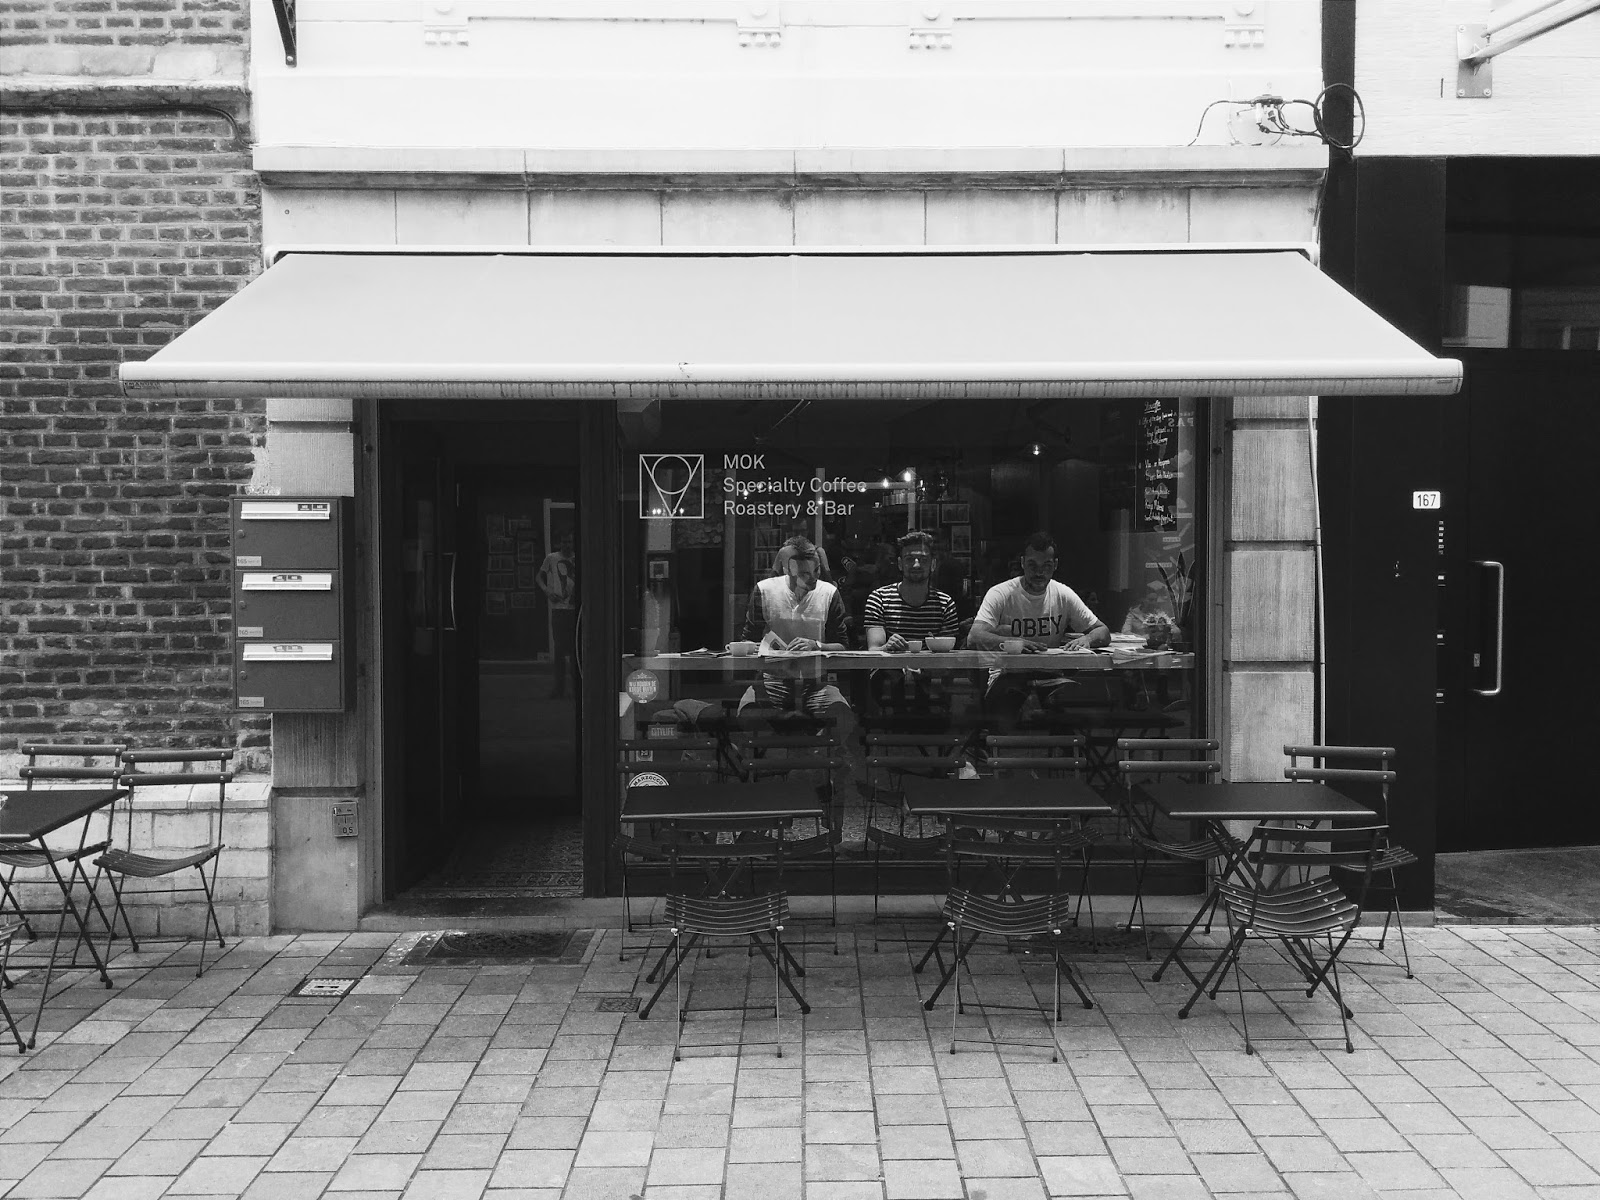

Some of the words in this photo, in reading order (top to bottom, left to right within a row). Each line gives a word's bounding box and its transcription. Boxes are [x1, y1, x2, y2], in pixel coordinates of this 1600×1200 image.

[723, 454, 765, 470] MOK
[723, 477, 805, 497] Specialty
[810, 477, 867, 493] Coffee
[1417, 494, 1436, 506] 167
[724, 500, 801, 520] Roastery
[806, 500, 819, 516] &
[825, 500, 855, 516] Bar
[1011, 615, 1063, 637] OBEY
[651, 727, 675, 737] CITYLIFE
[633, 775, 664, 786] MARZOCCO
